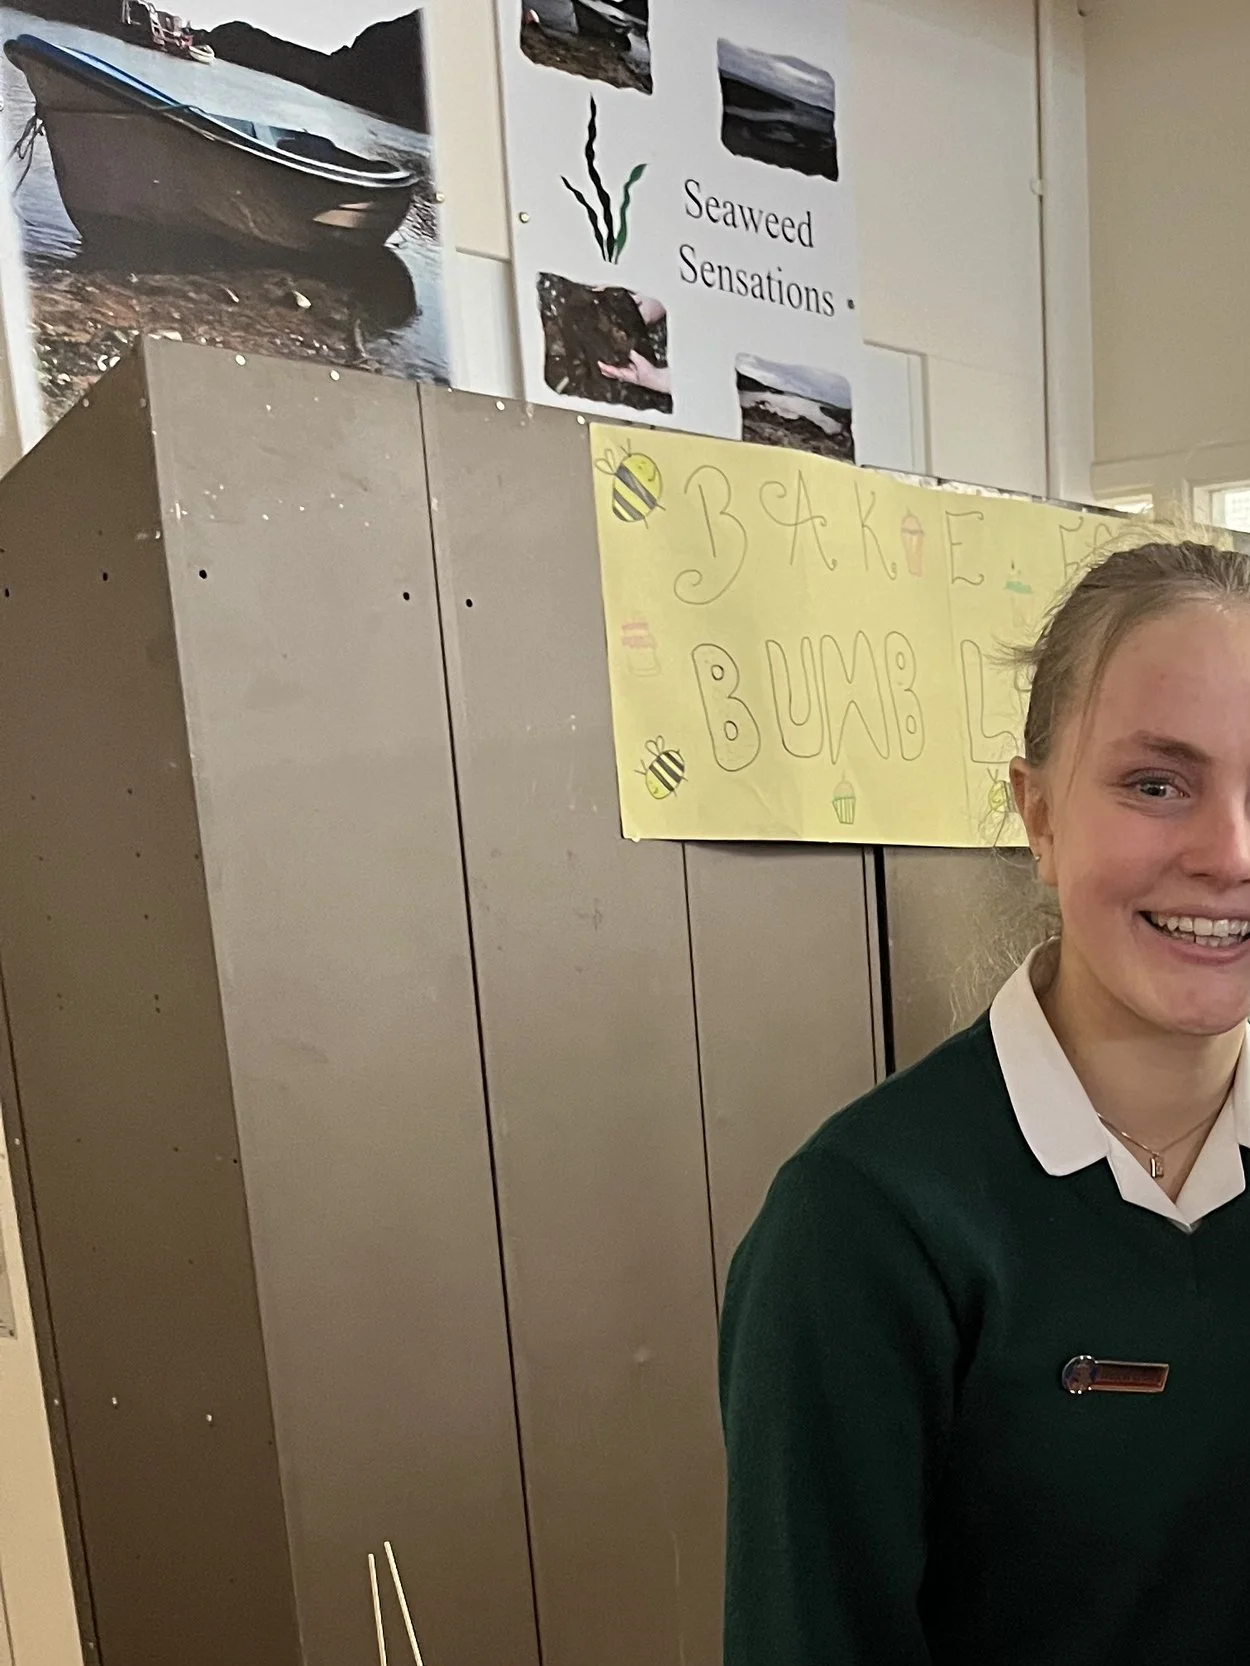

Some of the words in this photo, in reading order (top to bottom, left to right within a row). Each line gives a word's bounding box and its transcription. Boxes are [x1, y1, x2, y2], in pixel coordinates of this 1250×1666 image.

[684, 179, 814, 248] Seaweed
[679, 244, 835, 317] Sensations
[674, 465, 985, 605] BAKE
[691, 631, 1033, 771] BUMBL
